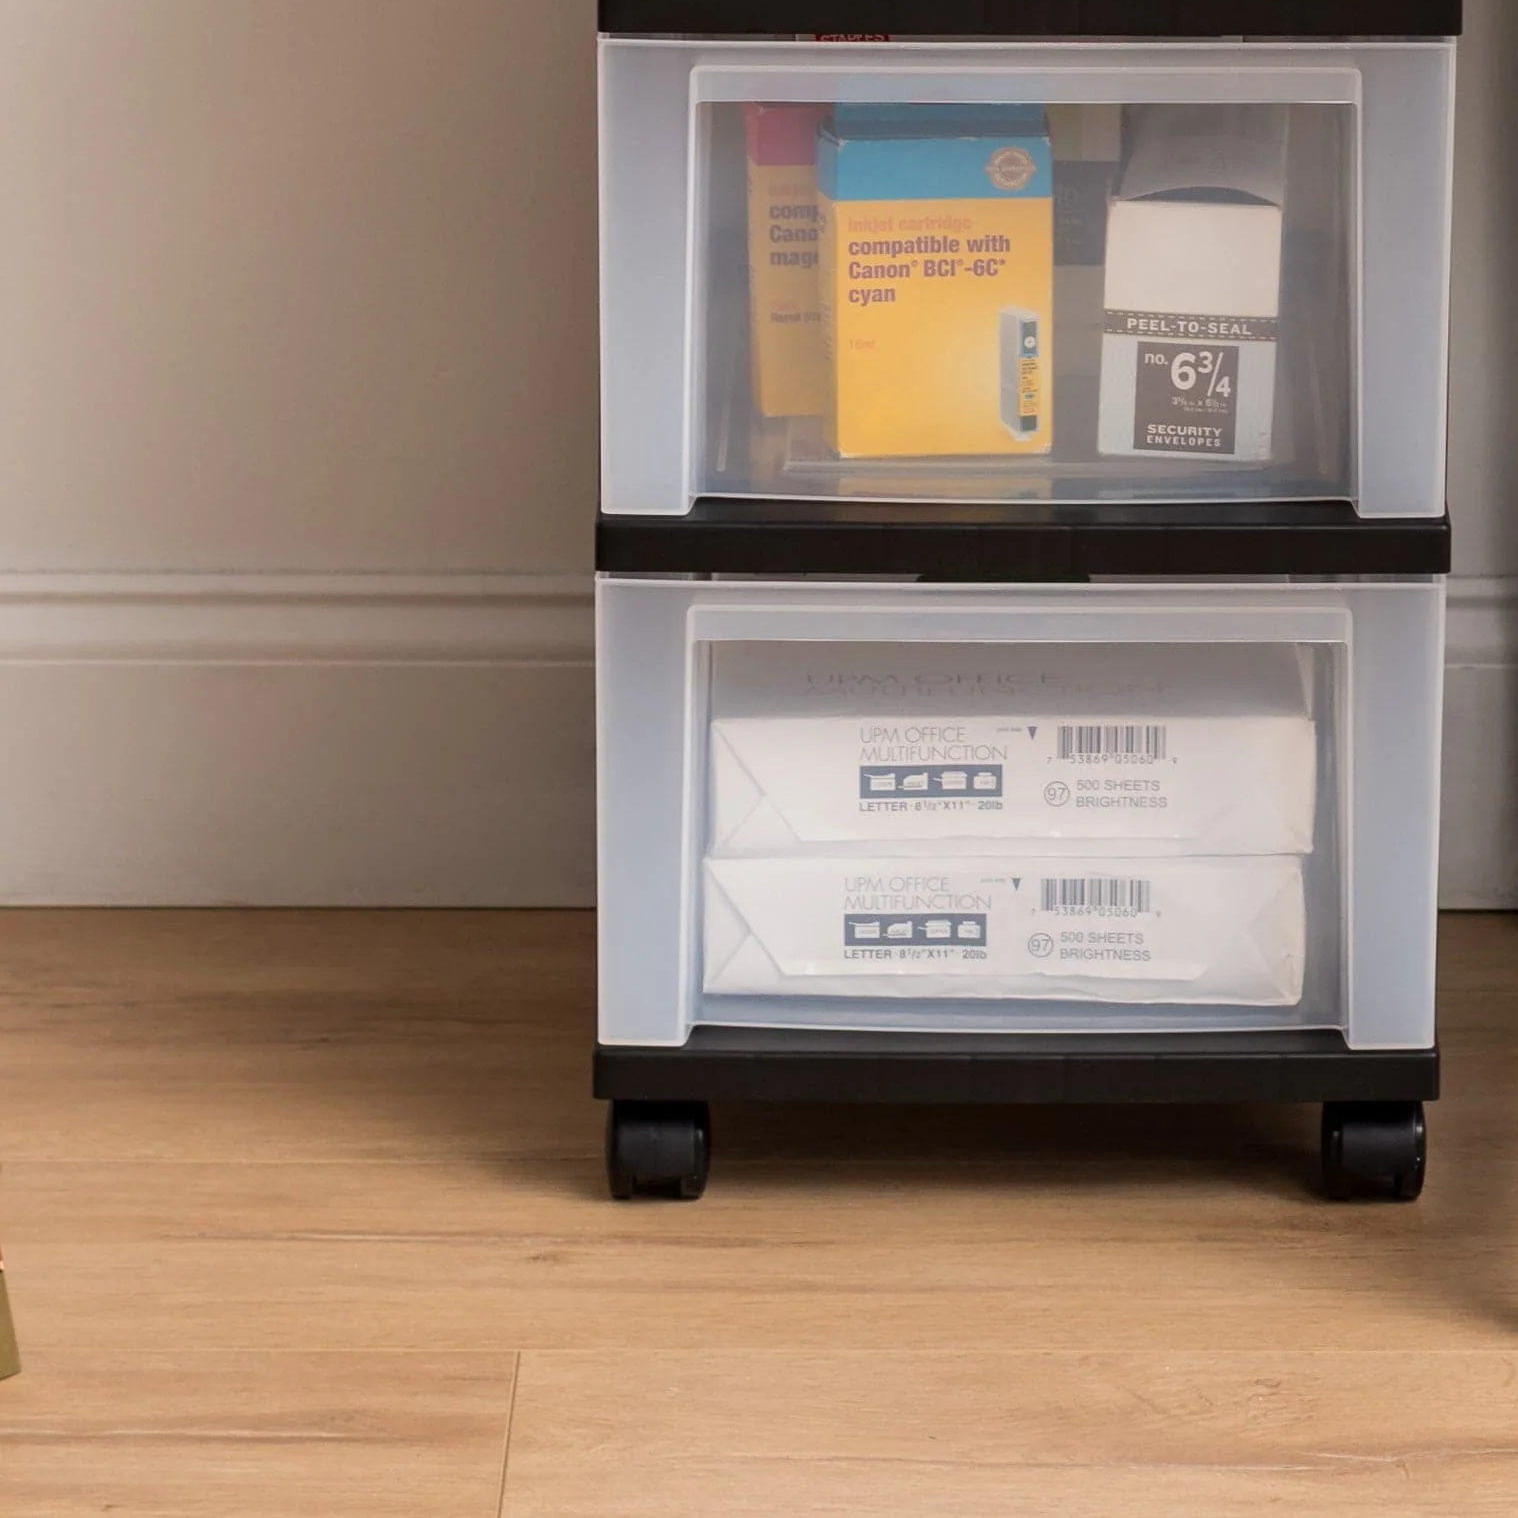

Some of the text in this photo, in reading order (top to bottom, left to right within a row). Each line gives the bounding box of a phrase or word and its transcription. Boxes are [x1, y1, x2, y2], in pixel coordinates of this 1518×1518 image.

[848, 234, 1011, 258] compatible with
[848, 287, 896, 307] cyan
[1127, 318, 1253, 335] PEEL-TO-SEAL
[1144, 353, 1169, 365] no.
[1147, 424, 1223, 437] SECURITY
[1146, 435, 1222, 448] ENVELOPES
[860, 726, 966, 744] UPM OFFICE
[860, 745, 1008, 762] MULTIFUNCTION
[1049, 780, 1160, 801] 97 500 SHEETS
[859, 802, 908, 812] LETTER
[978, 801, 1003, 811] 20lb
[1076, 796, 1168, 808] BRIGHTNESS
[845, 876, 949, 892] UPM OFFICE
[844, 894, 992, 910] MULTIFUNCTION
[1033, 932, 1144, 952] 97 500 SHEETS
[844, 949, 892, 960] LETTER
[962, 949, 987, 960] 20lb
[1060, 949, 1152, 962] BRIGHTNESS
